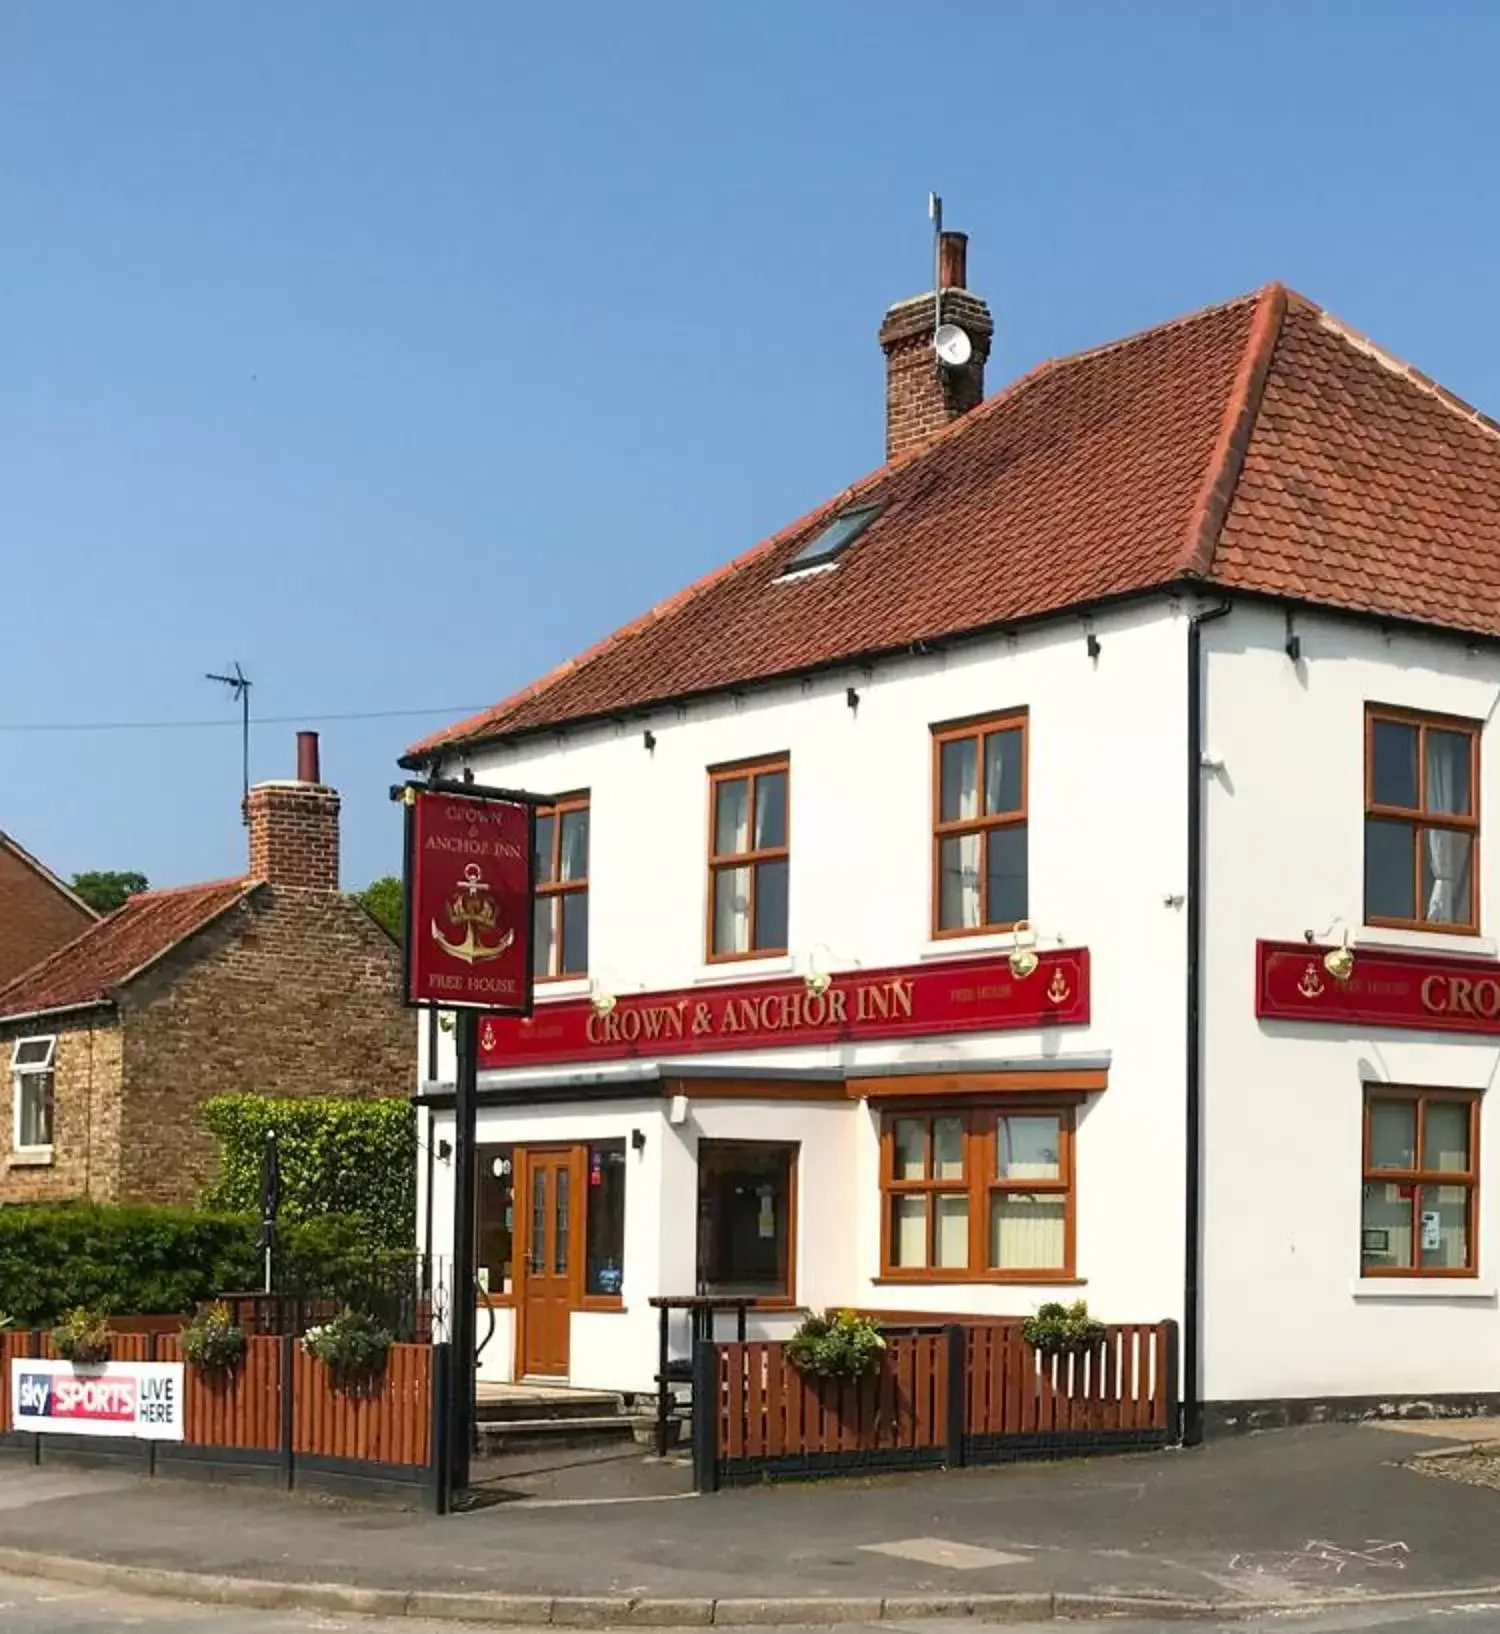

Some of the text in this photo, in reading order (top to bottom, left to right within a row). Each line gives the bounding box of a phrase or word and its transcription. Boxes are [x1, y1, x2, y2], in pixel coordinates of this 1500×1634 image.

[494, 840, 523, 858] INN
[429, 974, 516, 993] FREE HOUSE
[586, 980, 914, 1045] CROWN & ANCHOR INN
[20, 1376, 135, 1415] sky SPORTS
[141, 1378, 173, 1400] LIVE
[140, 1403, 173, 1423] HERE
